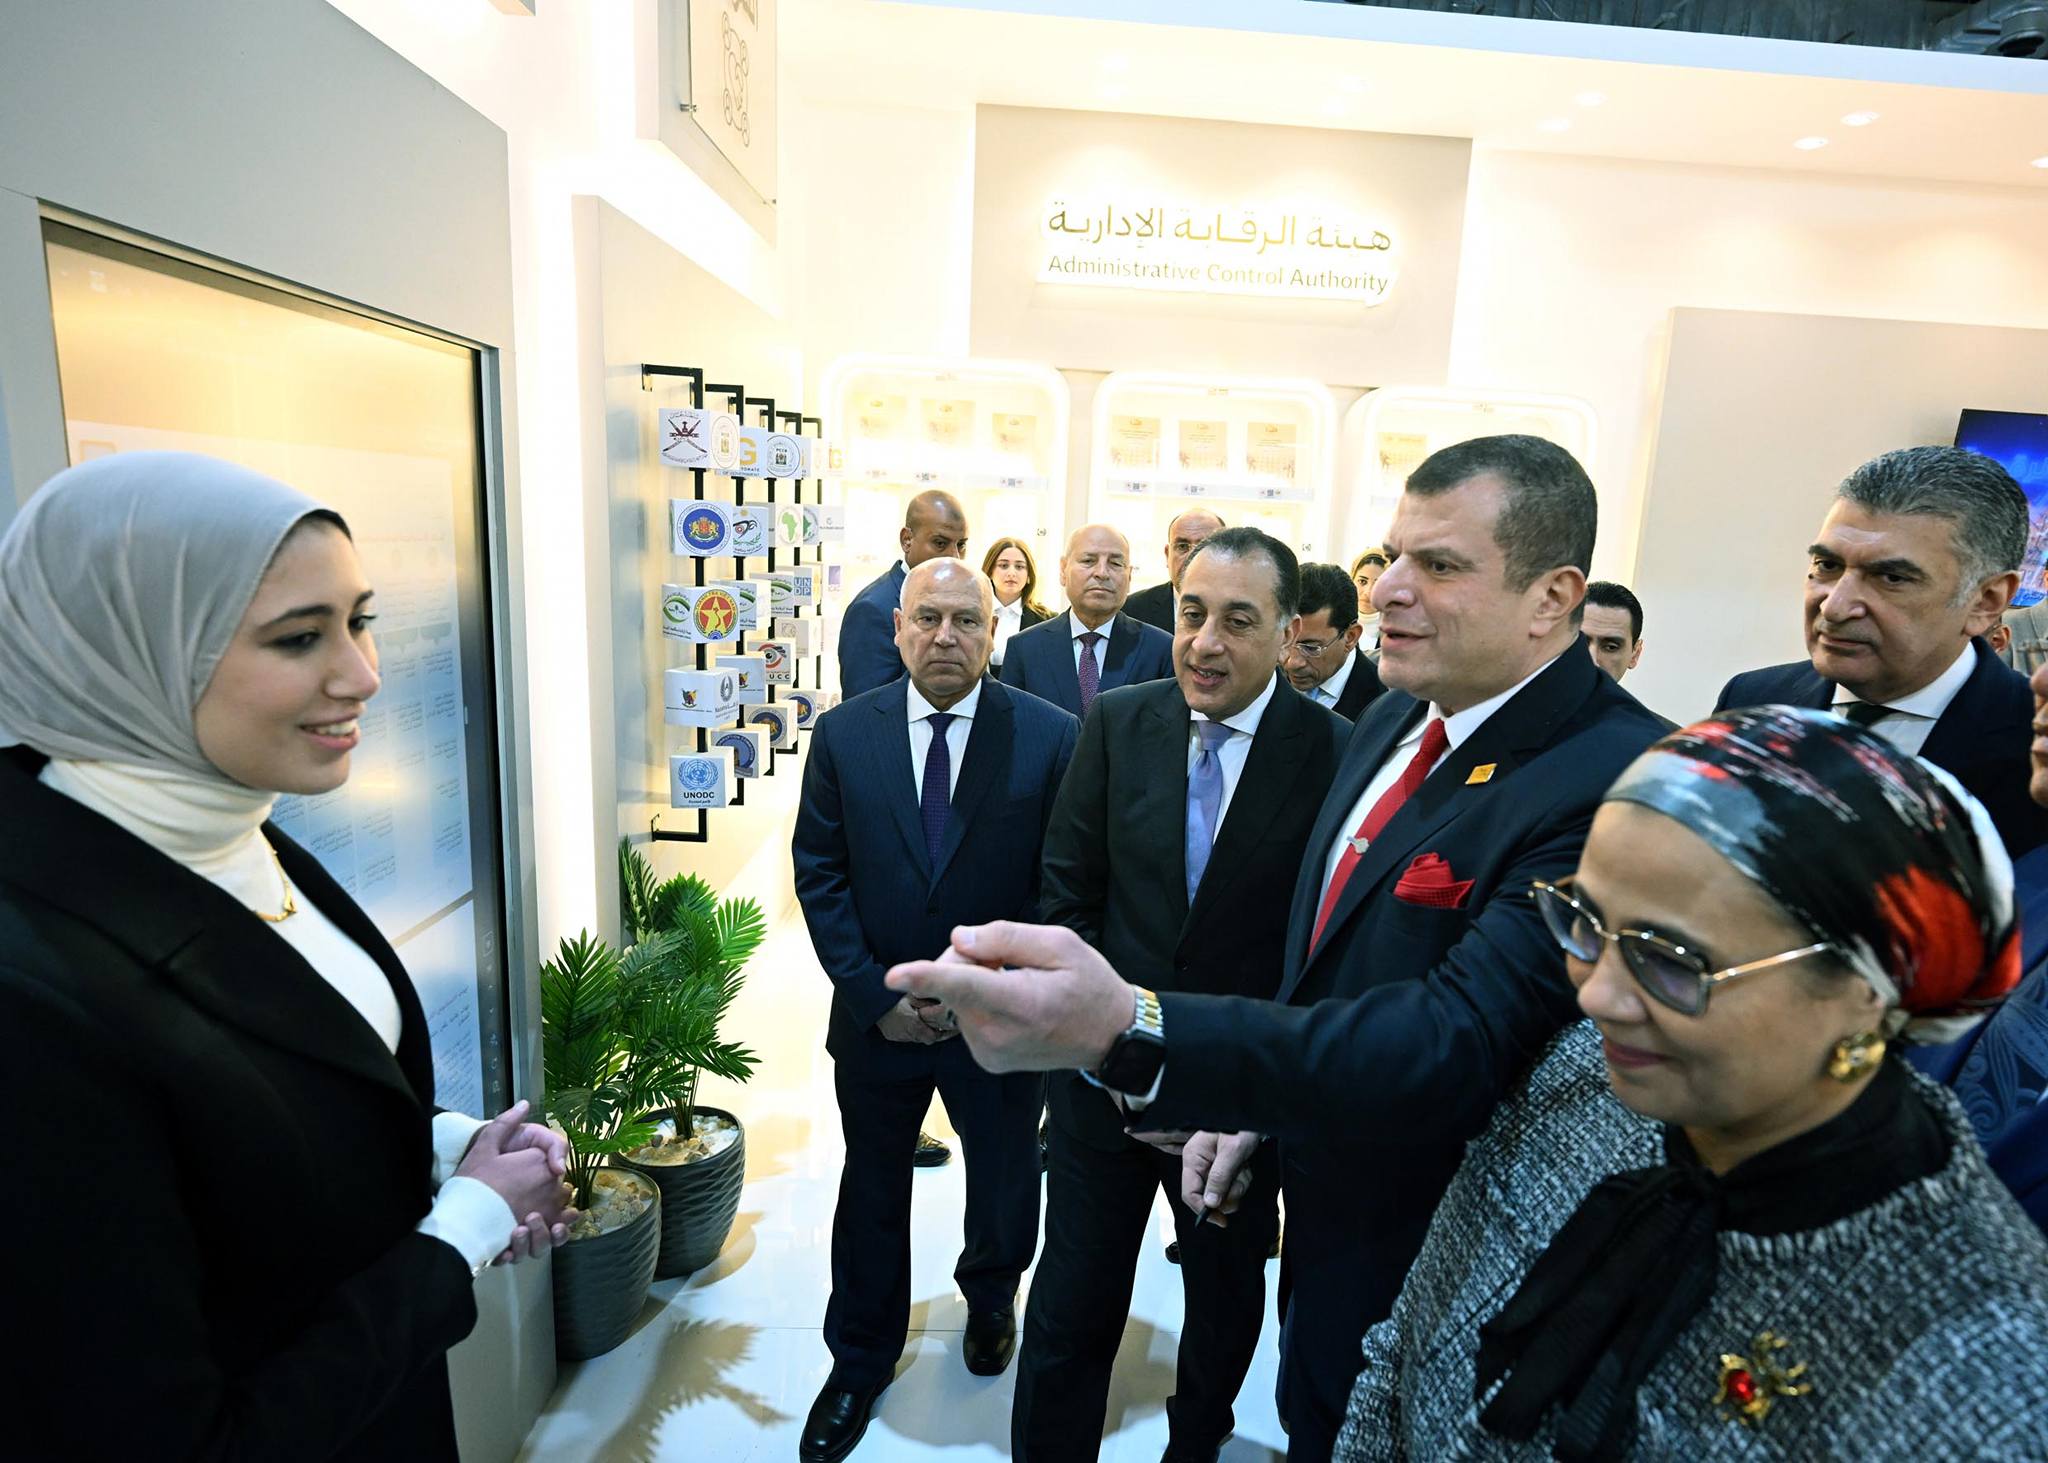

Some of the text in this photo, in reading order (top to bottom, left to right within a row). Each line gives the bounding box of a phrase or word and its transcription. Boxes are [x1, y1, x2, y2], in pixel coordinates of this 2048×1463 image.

[1047, 200, 1393, 256] هيئة الرقابة الإدارية
[1047, 254, 1389, 297] Administrative Control Authority
[794, 577, 811, 586] UN
[794, 587, 811, 596] DP
